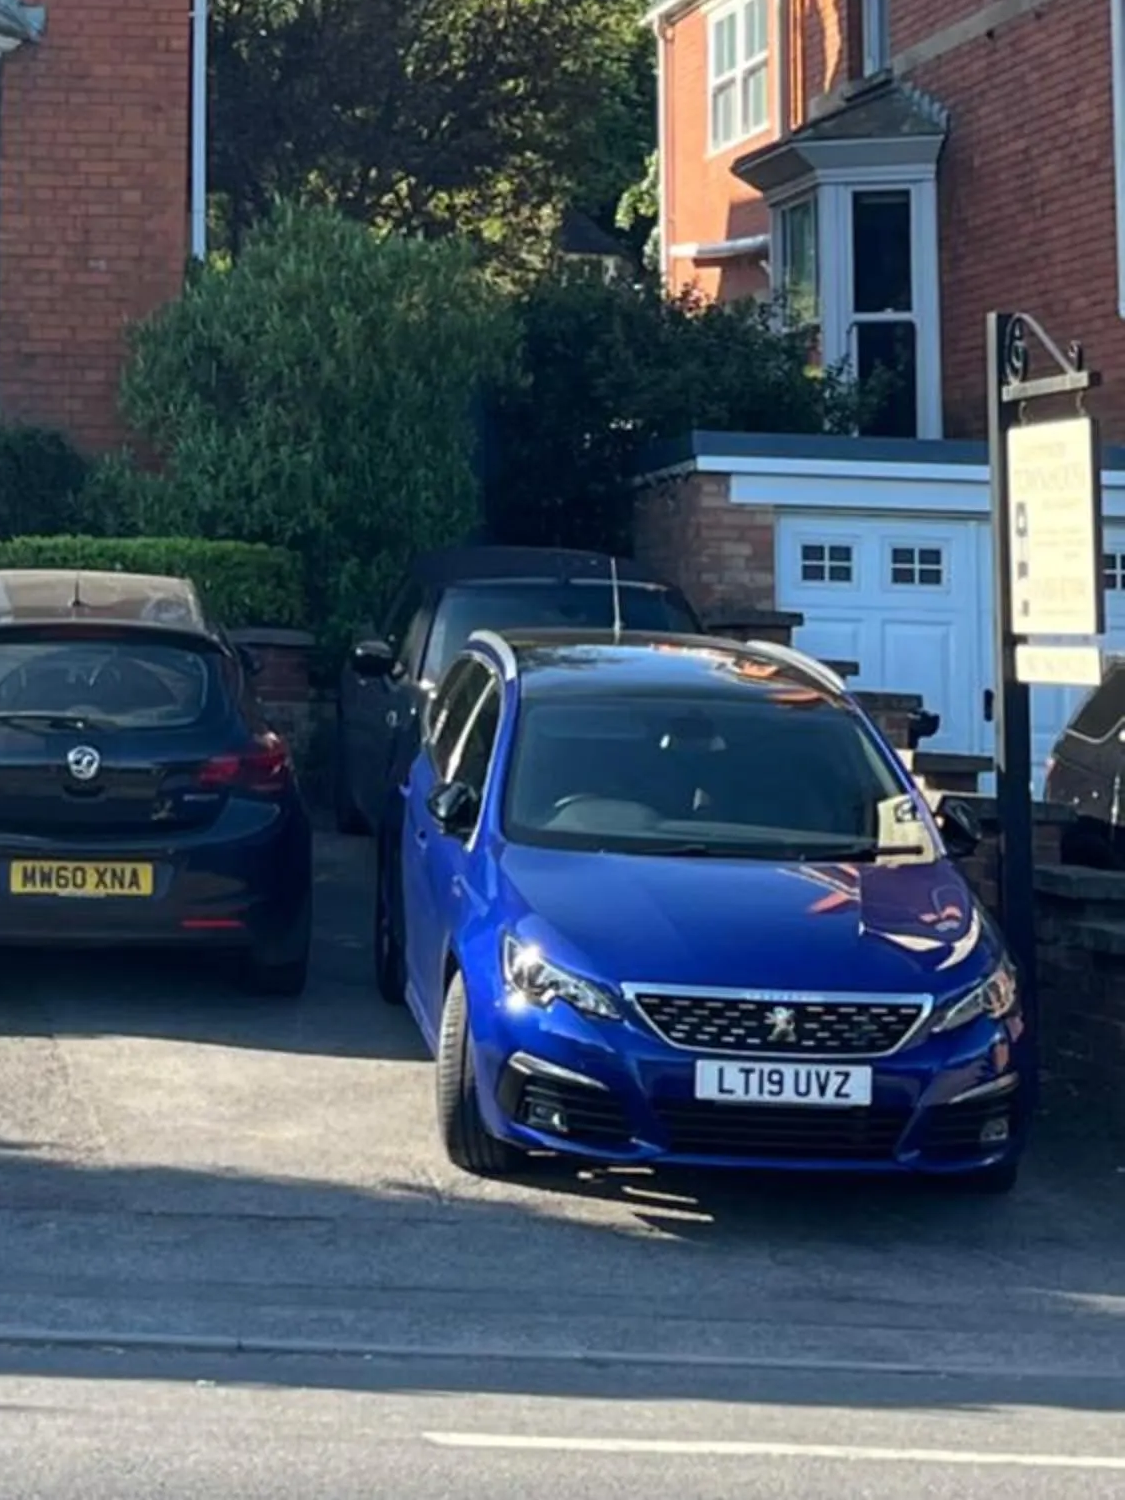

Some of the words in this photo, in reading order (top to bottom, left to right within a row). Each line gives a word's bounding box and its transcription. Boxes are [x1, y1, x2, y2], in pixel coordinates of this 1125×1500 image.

[22, 866, 87, 889] MW60
[94, 867, 141, 891] XNA
[718, 1067, 784, 1097] LT19
[794, 1069, 851, 1098] UVZ
